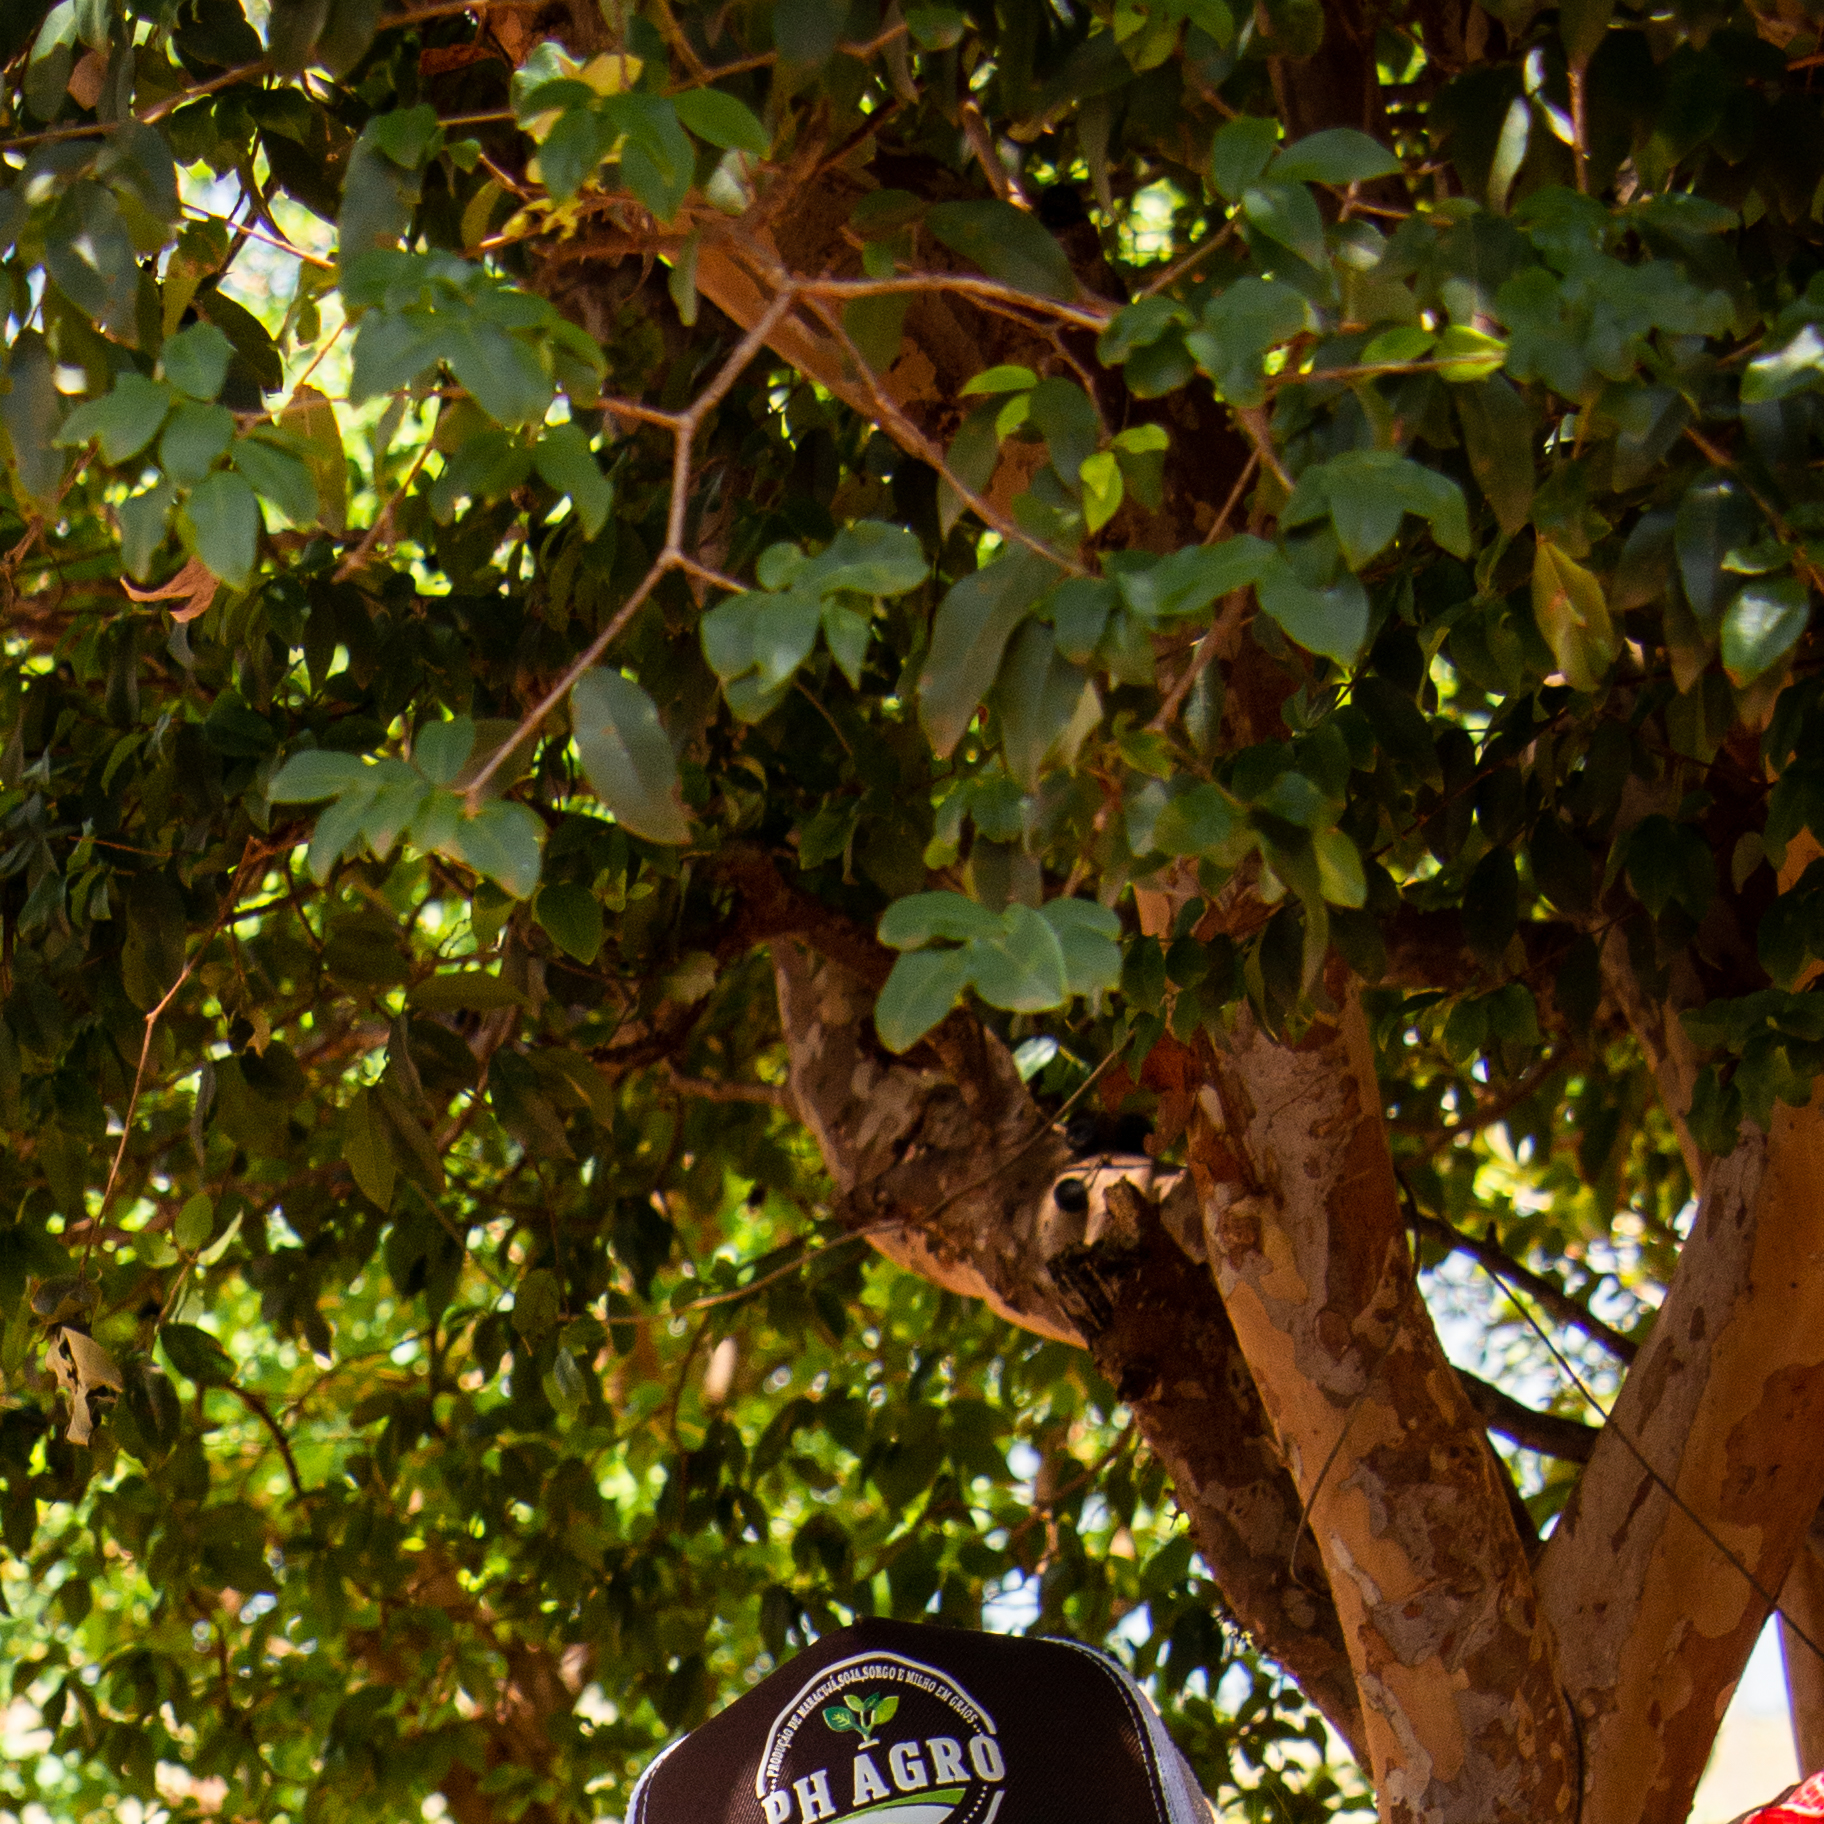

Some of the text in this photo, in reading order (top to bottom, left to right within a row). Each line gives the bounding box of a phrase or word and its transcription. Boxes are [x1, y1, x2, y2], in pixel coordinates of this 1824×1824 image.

[766, 1727, 795, 1778] PRODUÇÃO
[787, 1713, 803, 1731] DE
[896, 1667, 906, 1682] E
[905, 1670, 937, 1693] MILHO
[935, 1684, 953, 1703] EM
[853, 1734, 1006, 1807] AGRO
